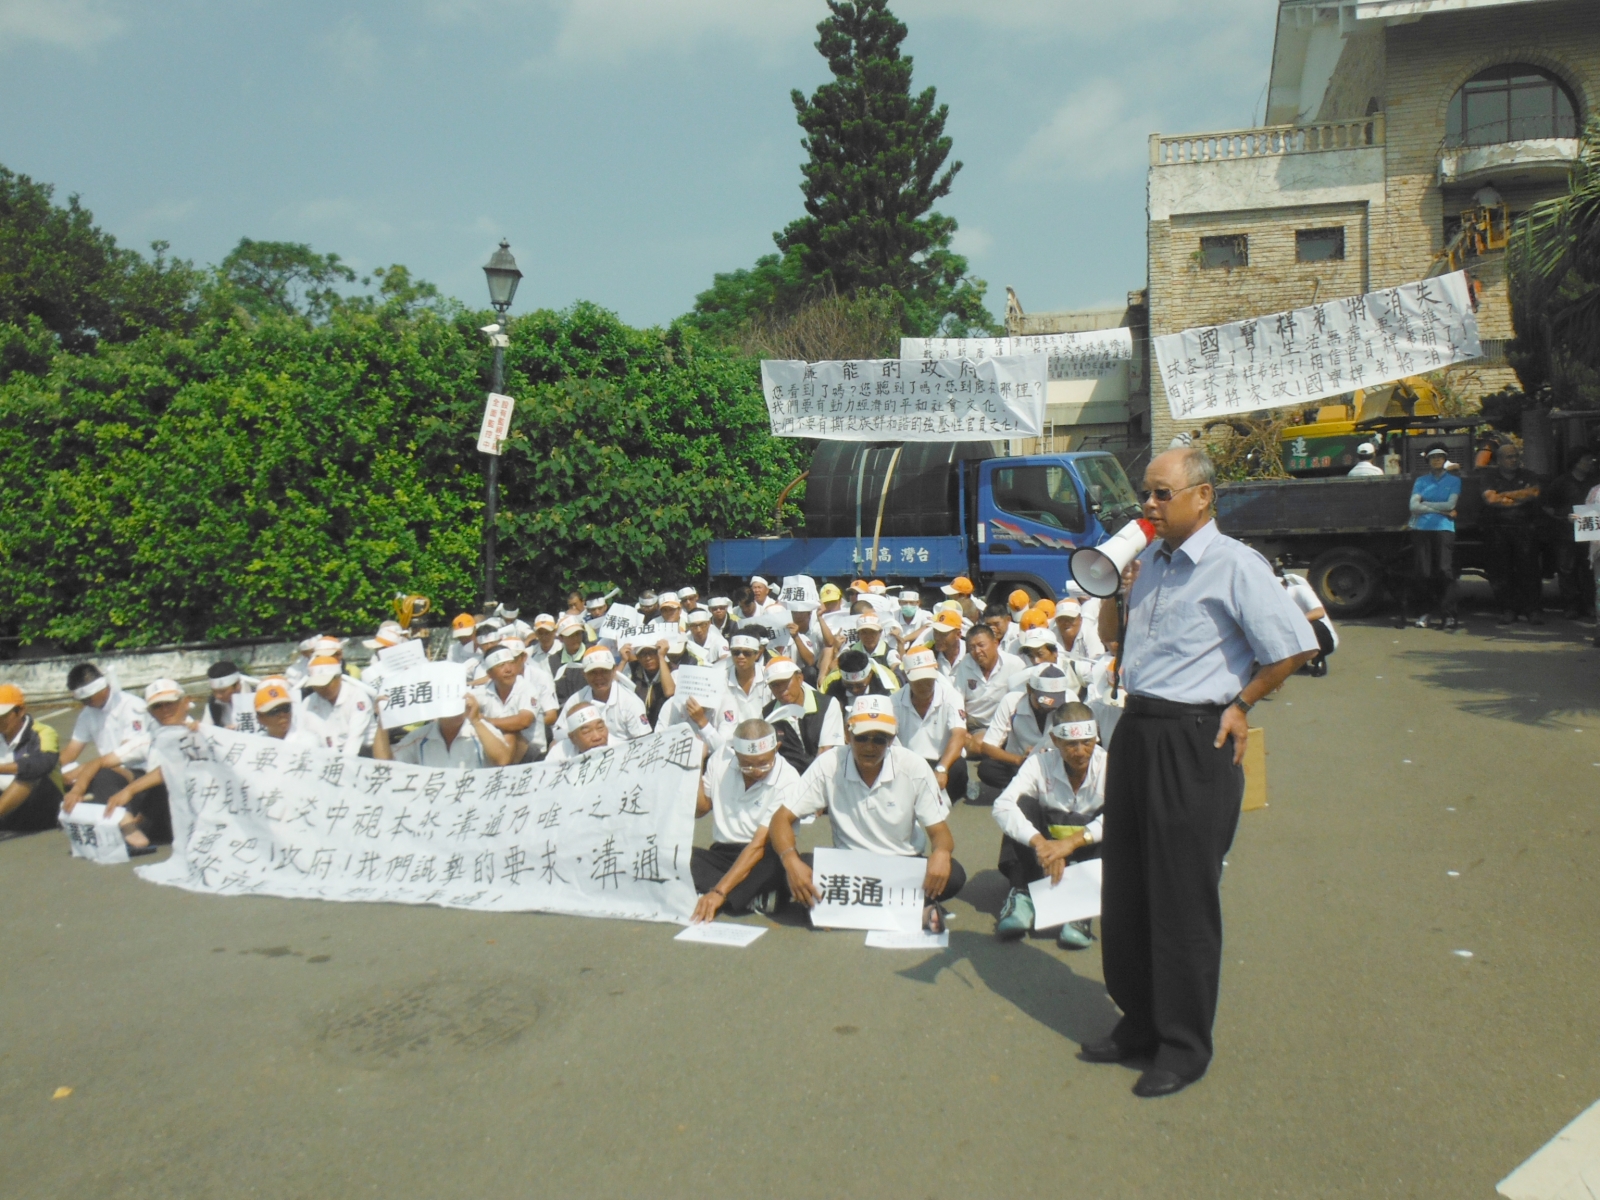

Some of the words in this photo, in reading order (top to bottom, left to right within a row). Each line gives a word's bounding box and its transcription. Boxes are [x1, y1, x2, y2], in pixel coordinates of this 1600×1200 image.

[801, 359, 979, 383] 廉能的政府
[1577, 515, 1600, 532] 溝
[383, 681, 460, 711] 溝通!!!
[819, 874, 917, 908] 溝通!!!
